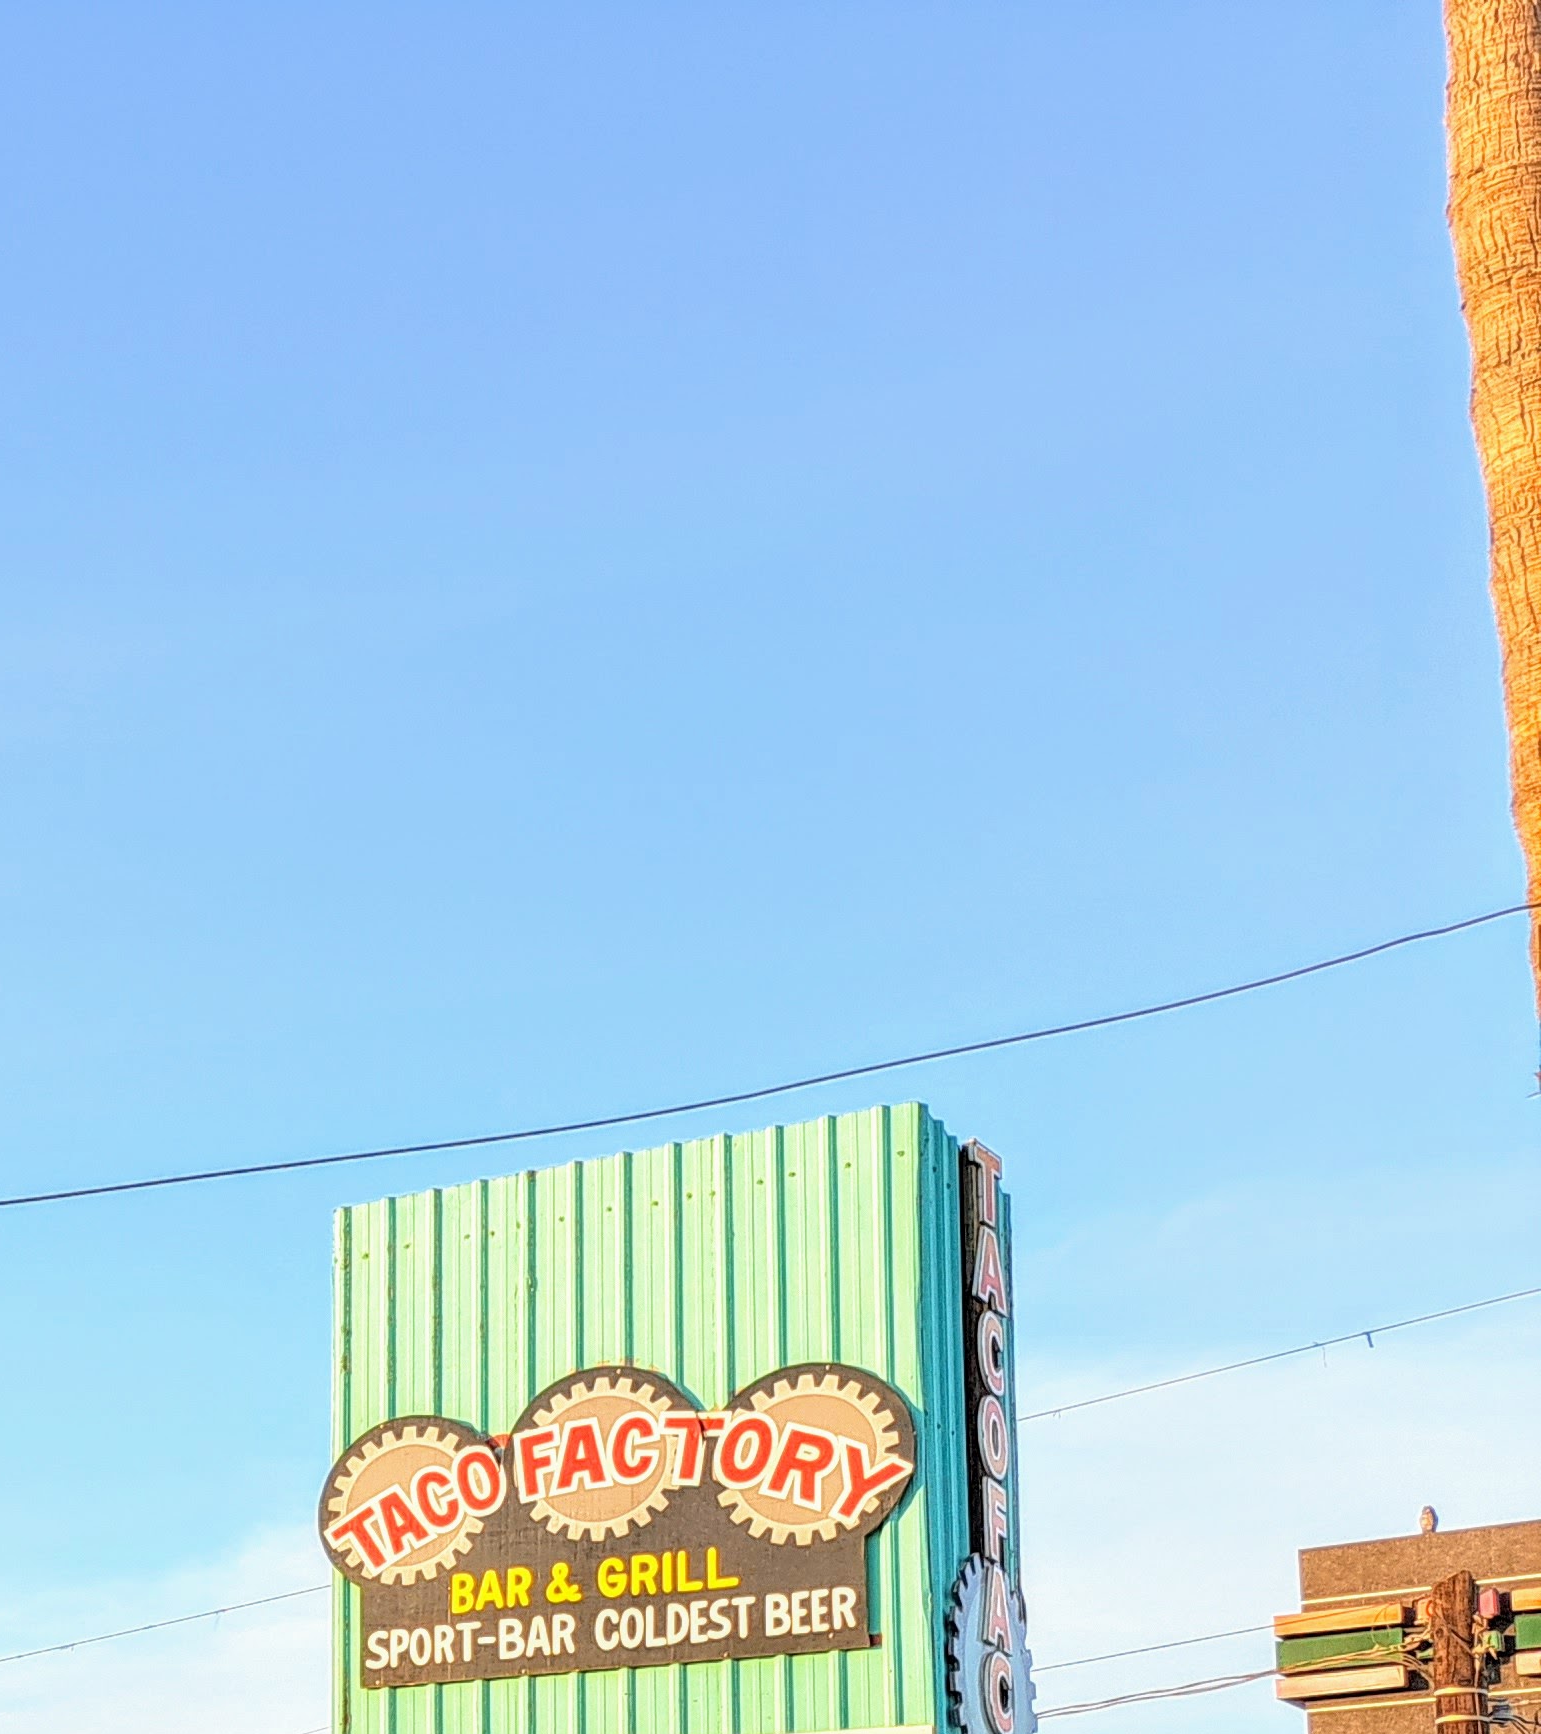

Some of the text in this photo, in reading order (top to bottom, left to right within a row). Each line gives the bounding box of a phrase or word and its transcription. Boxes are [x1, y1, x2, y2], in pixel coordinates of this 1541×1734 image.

[330, 1410, 912, 1571] TACO FACTORY
[451, 1548, 741, 1615] BAR & GRILL
[365, 1586, 858, 1670] SPORT-BAR COLDEST BEER
